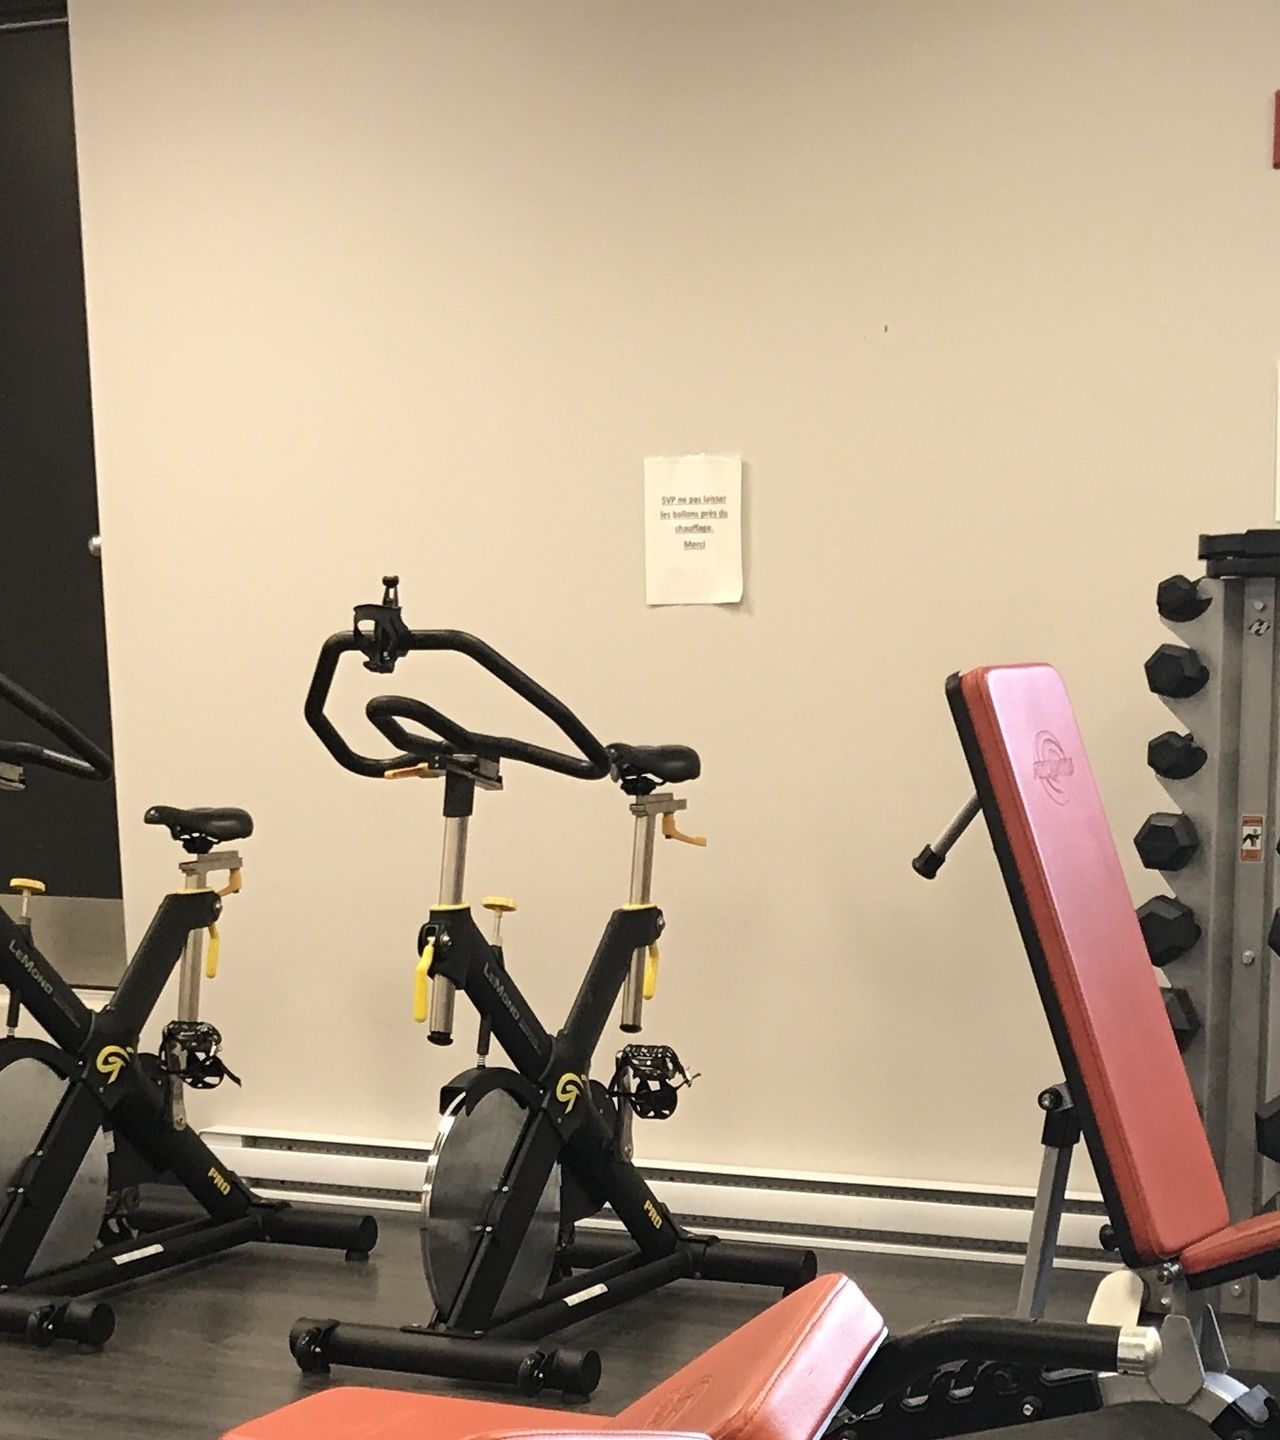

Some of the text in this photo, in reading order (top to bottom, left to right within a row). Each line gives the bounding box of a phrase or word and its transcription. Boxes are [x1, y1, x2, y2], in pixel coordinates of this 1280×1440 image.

[661, 496, 676, 504] SVP
[689, 496, 701, 505] pas
[207, 1166, 231, 1196] PRO
[643, 1199, 663, 1230] PRO
